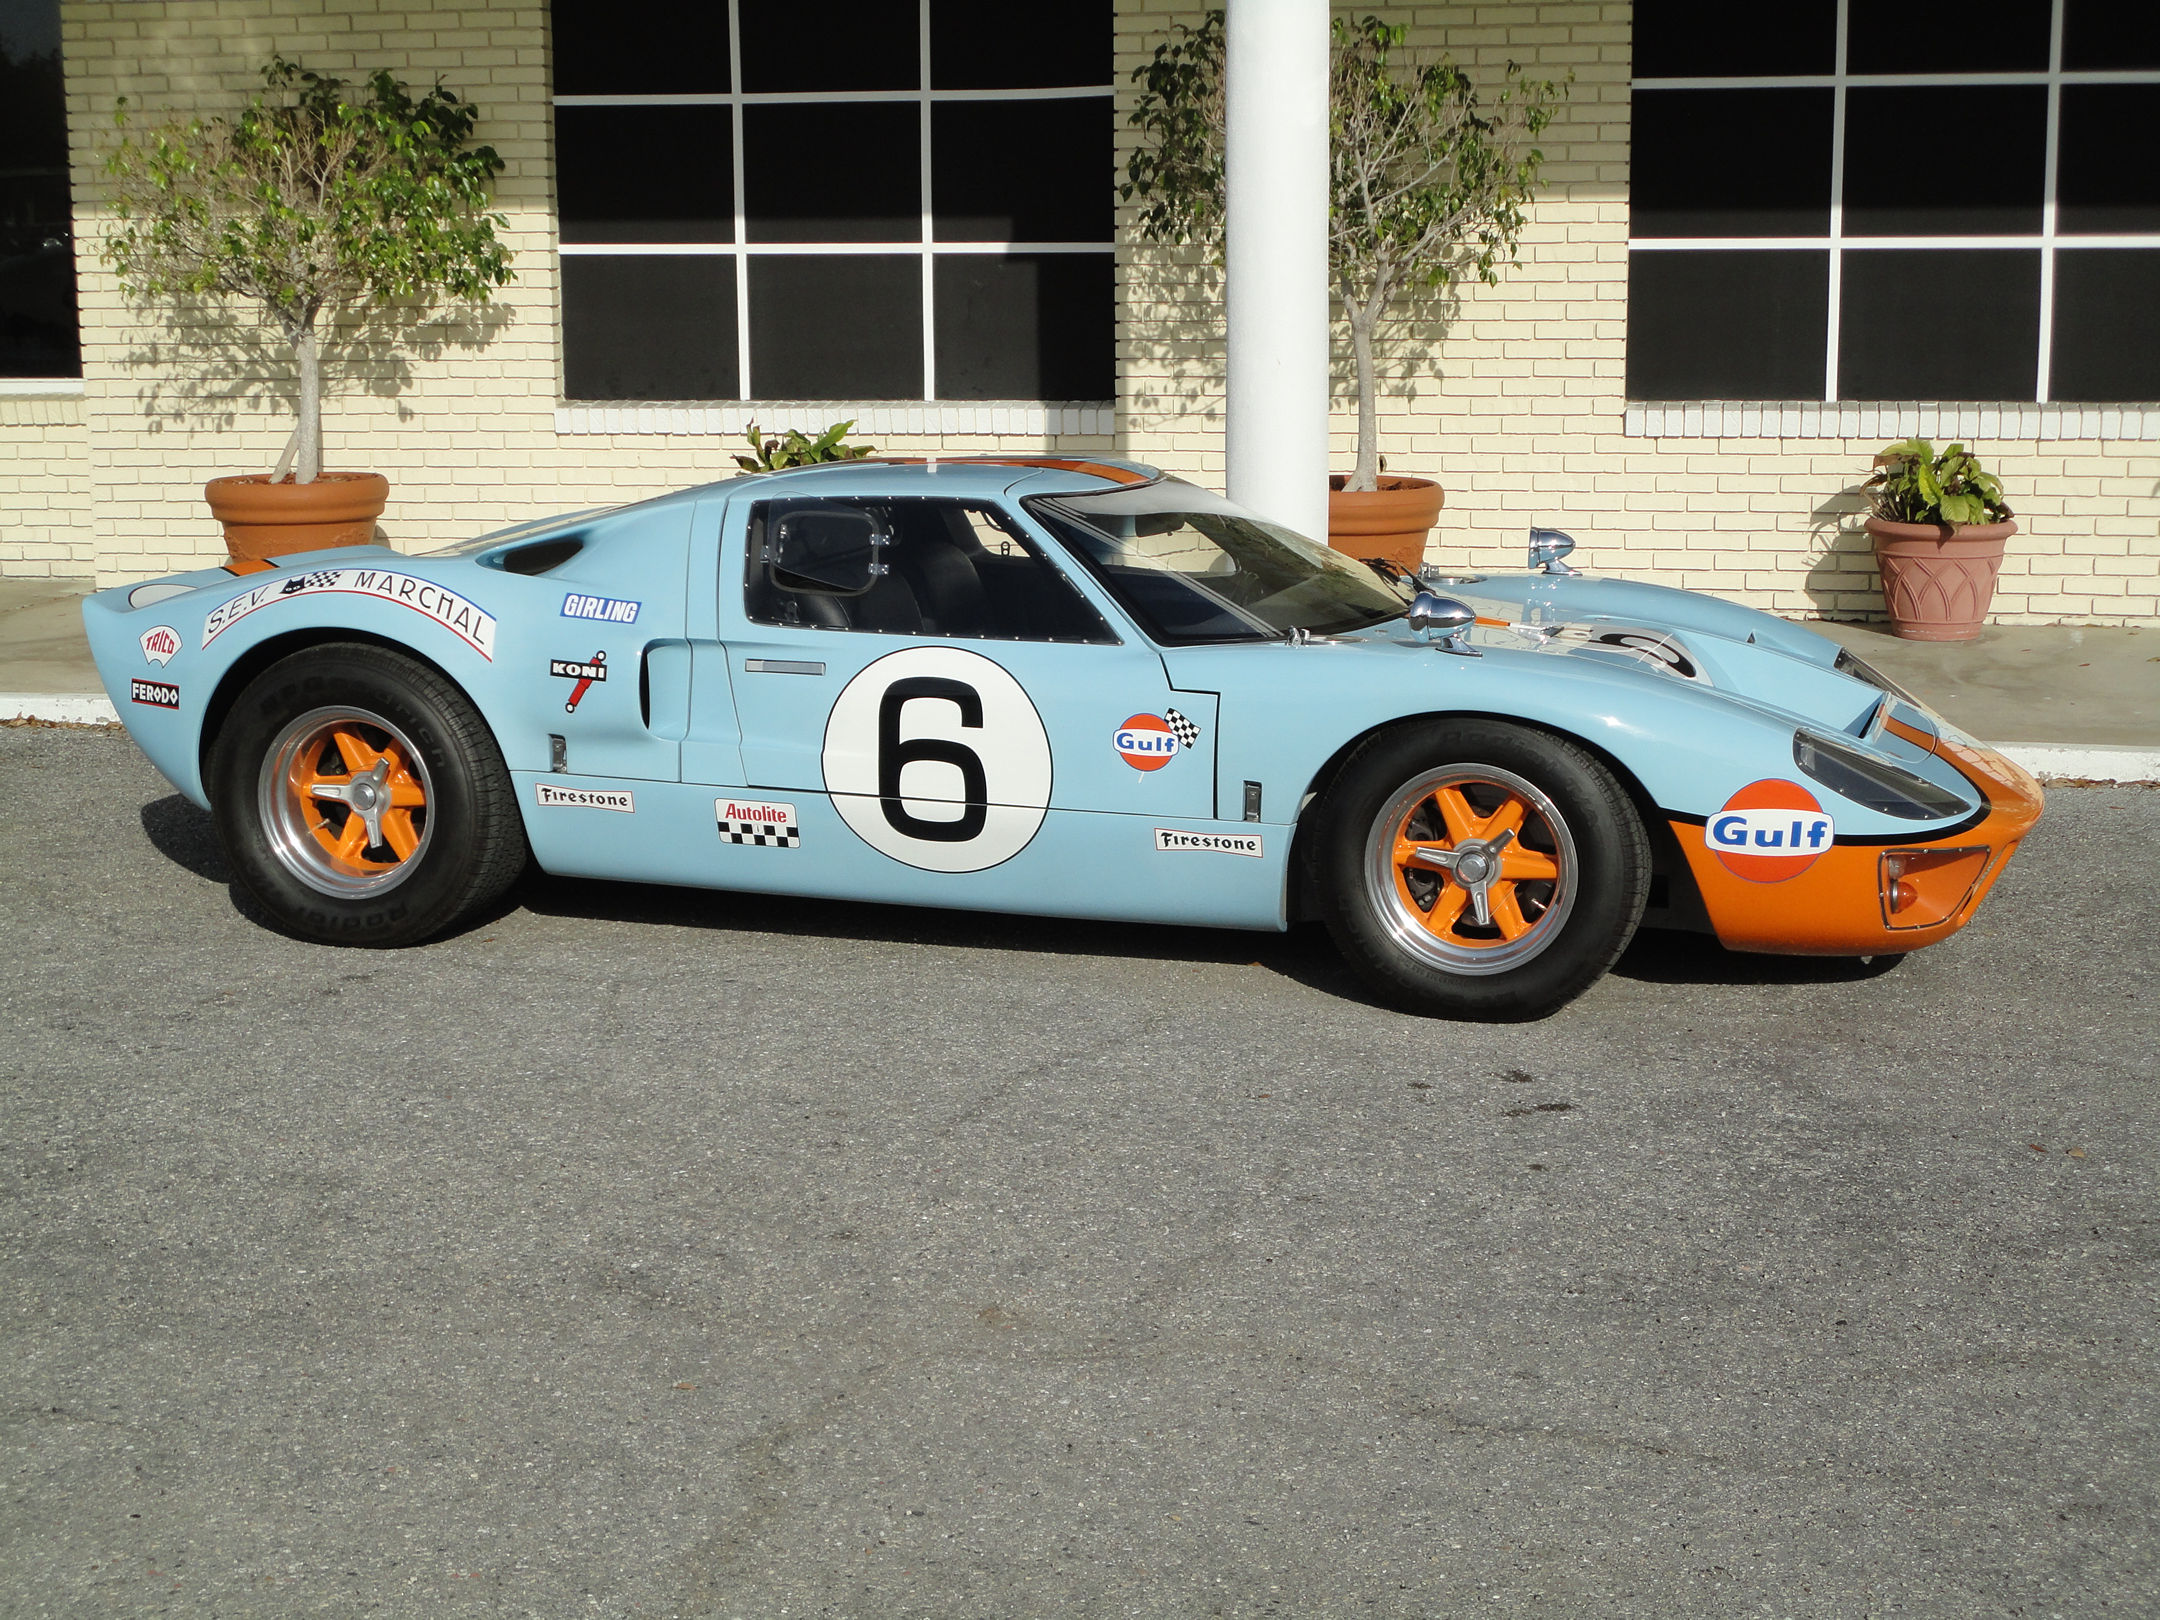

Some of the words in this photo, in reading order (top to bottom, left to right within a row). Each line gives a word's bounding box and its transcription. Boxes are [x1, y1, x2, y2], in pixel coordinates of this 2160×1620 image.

[208, 586, 270, 634] S.E.V.
[353, 571, 485, 645] MARCHAL
[563, 594, 638, 623] GIRLING
[146, 630, 175, 654] TRICO
[552, 662, 605, 678] KONI
[132, 682, 178, 705] FERODO
[1116, 733, 1175, 752] Gulf
[878, 676, 988, 842] 6
[541, 788, 628, 806] Firestone
[725, 803, 787, 823] Autolite
[1160, 832, 1257, 851] Firestone
[1713, 816, 1828, 848] Gulf
